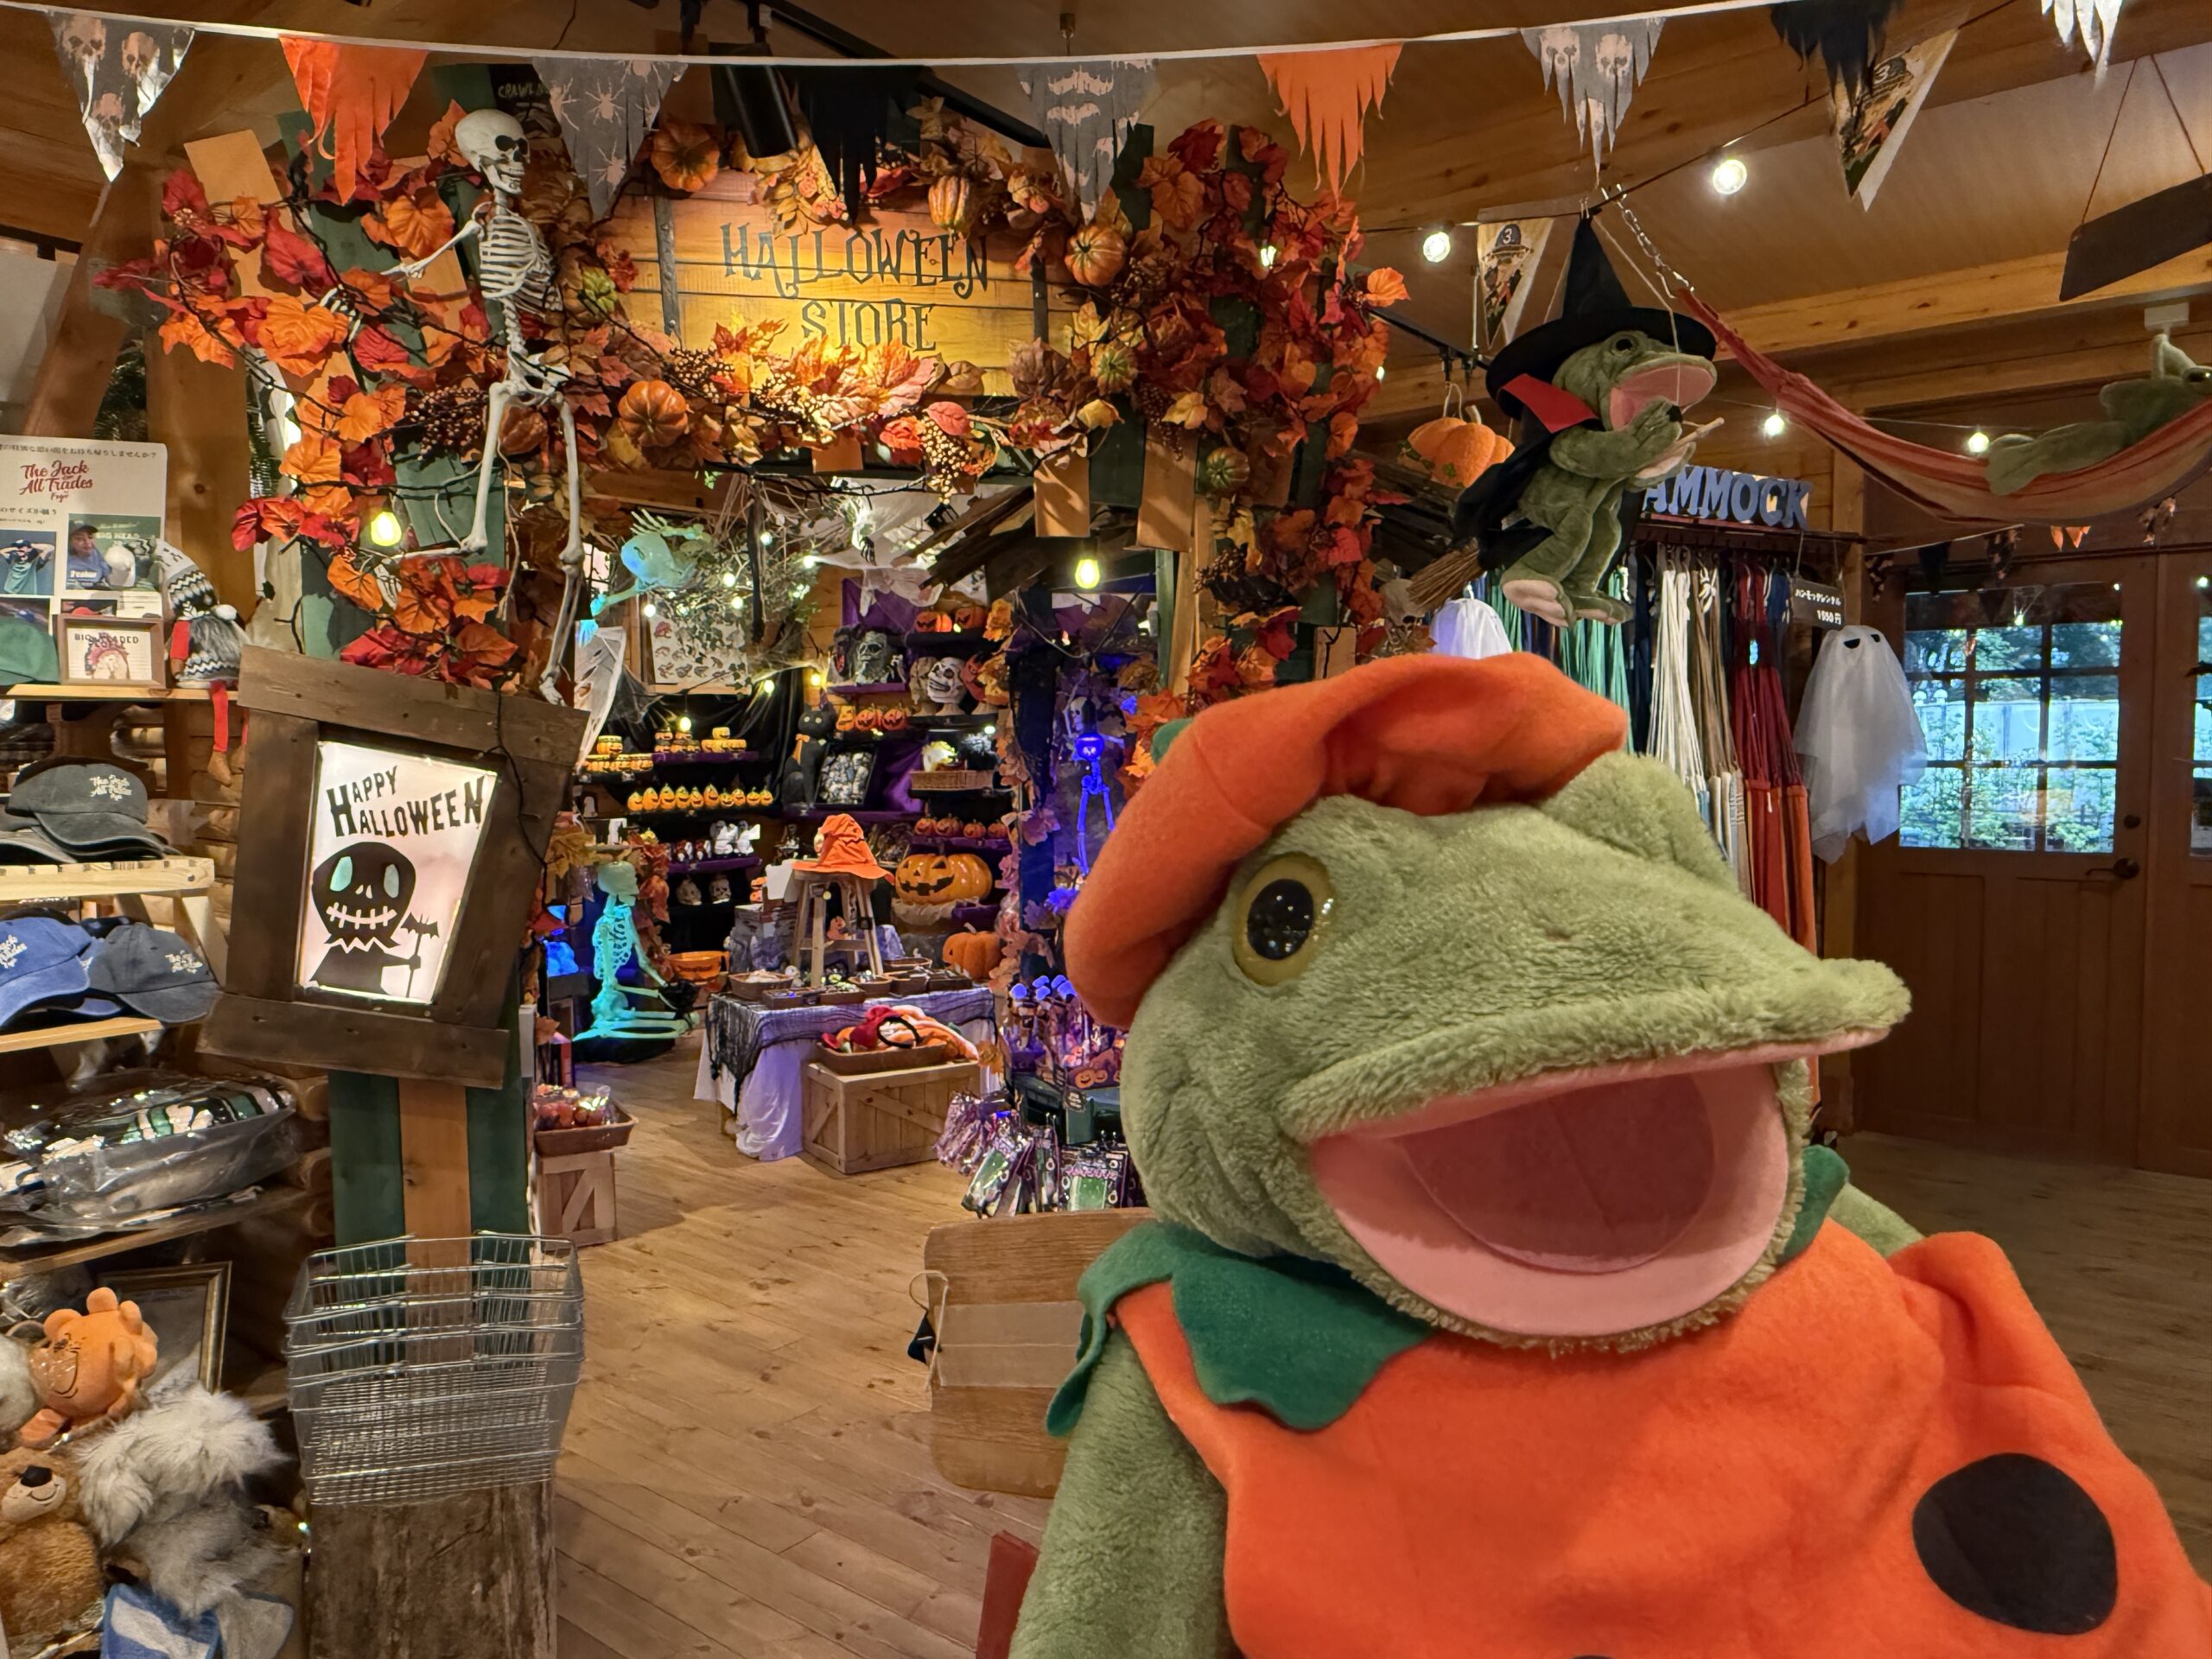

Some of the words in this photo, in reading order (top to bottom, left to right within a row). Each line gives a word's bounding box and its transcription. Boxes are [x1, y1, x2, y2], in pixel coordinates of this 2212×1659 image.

[1502, 227, 1513, 245] 3
[720, 222, 988, 300] HALLOWEEN
[801, 298, 937, 353] STORE
[19, 479, 46, 495] All
[46, 475, 93, 493] Trades
[21, 464, 48, 480] The
[51, 460, 90, 477] Jack
[327, 775, 485, 837] HALLOWEEN
